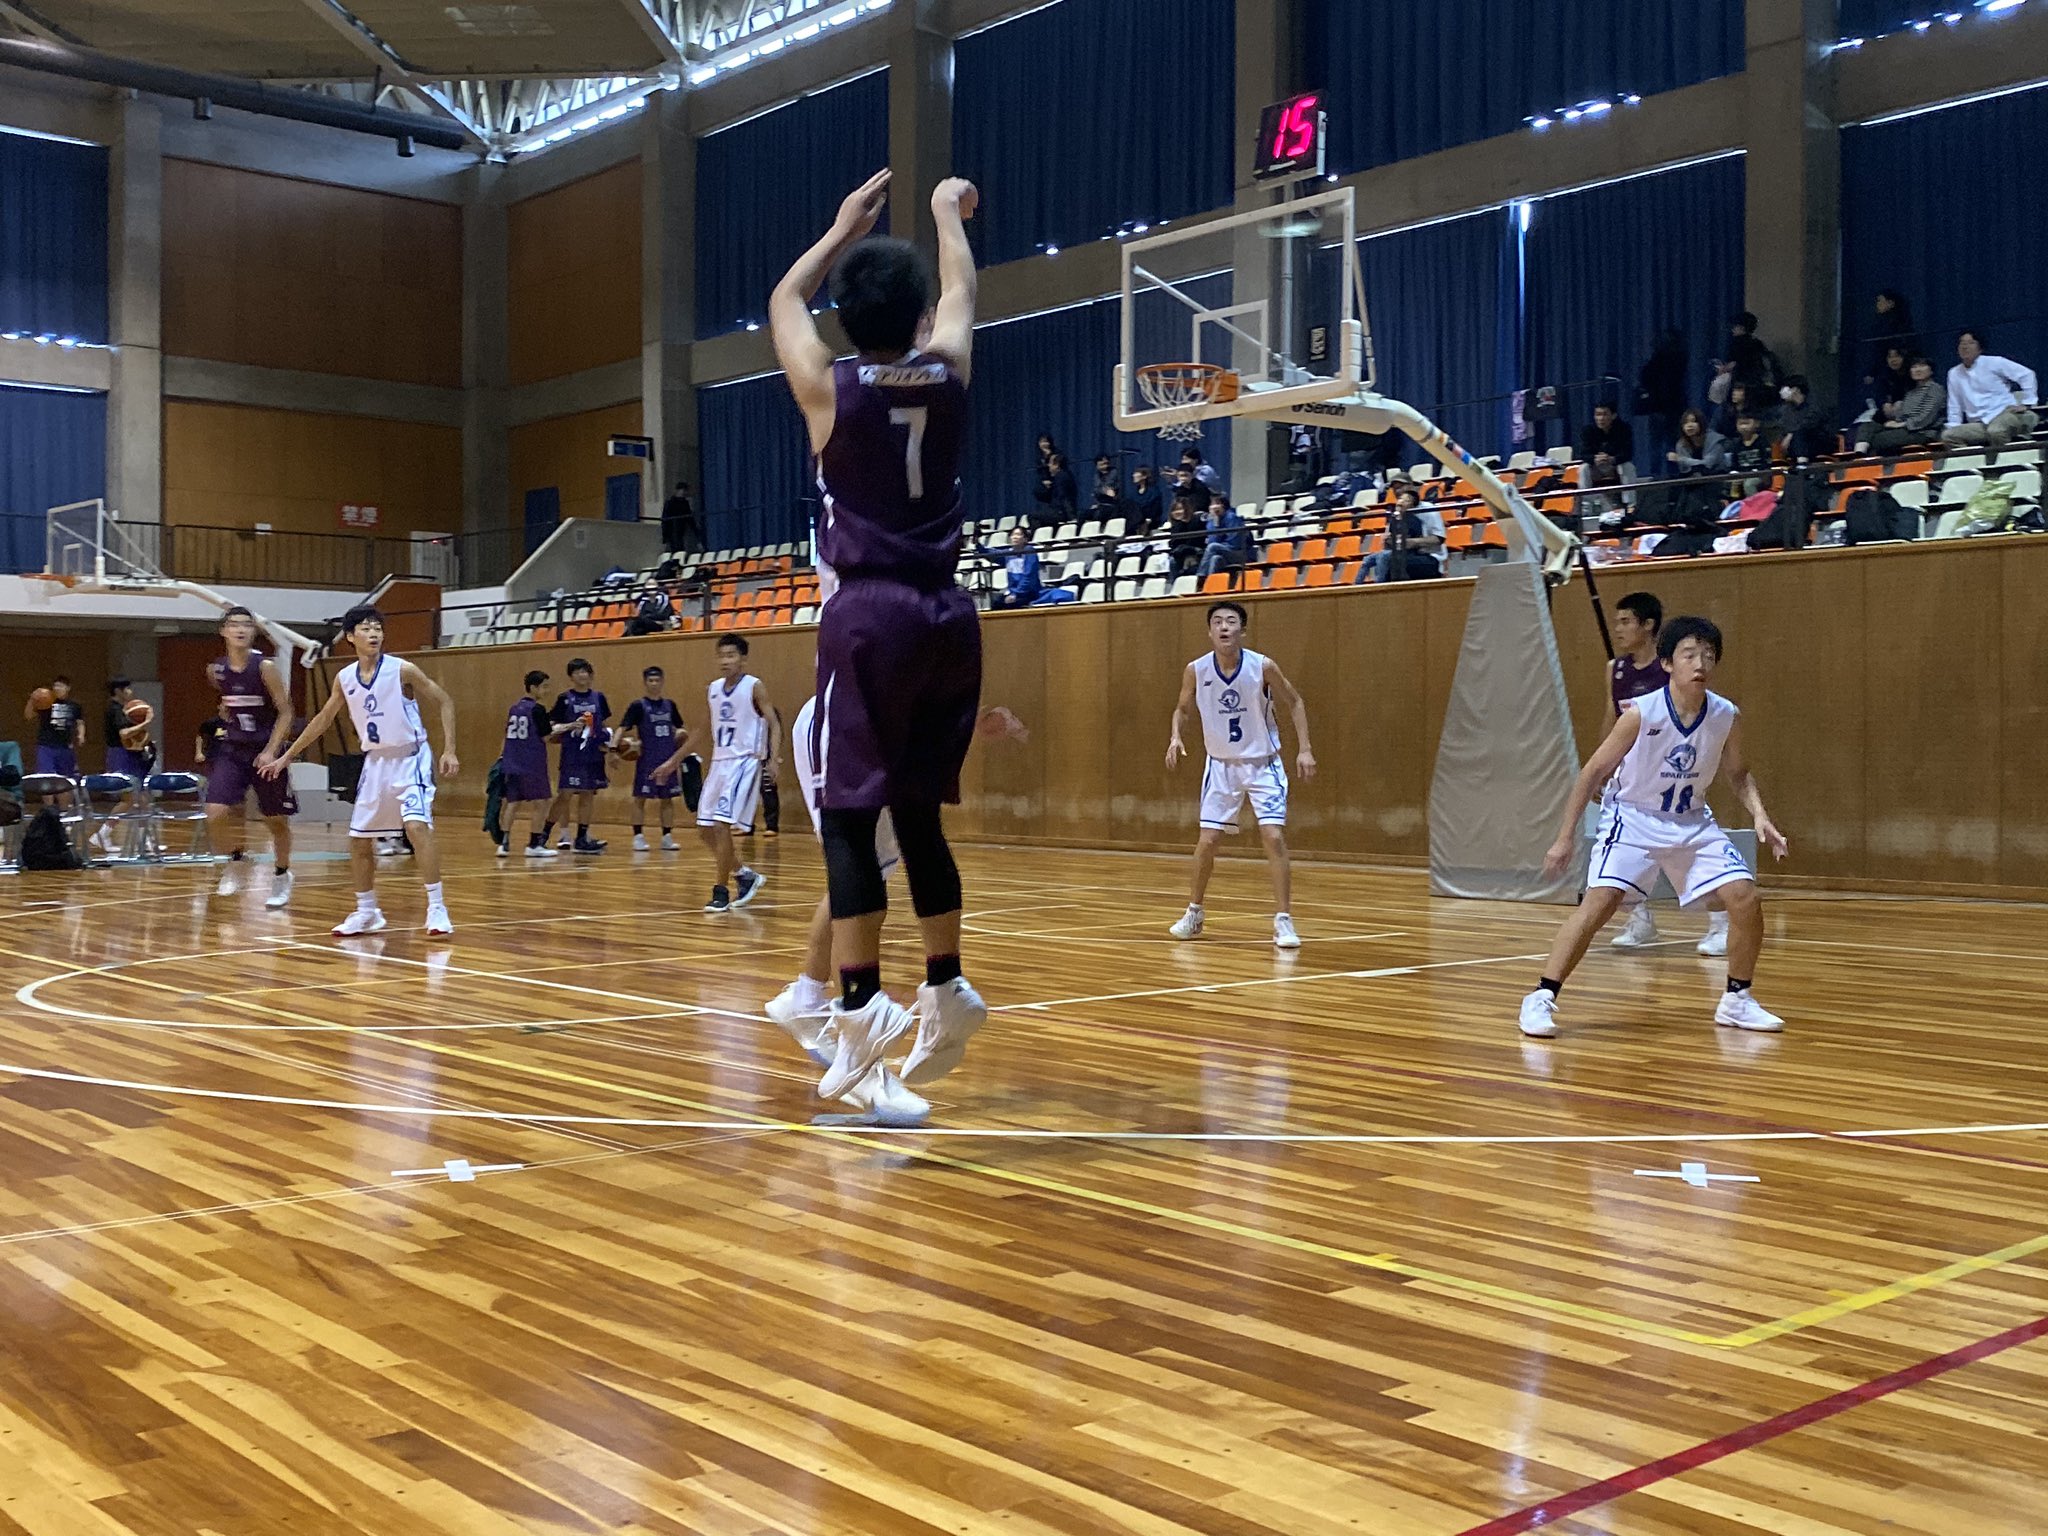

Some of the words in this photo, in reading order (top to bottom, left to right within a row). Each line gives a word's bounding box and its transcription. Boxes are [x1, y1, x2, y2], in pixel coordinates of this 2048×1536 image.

[1273, 96, 1318, 159] 15
[1303, 402, 1346, 417] Senoh
[888, 406, 928, 499] 7
[506, 715, 529, 740] 28
[717, 726, 736, 747] 17
[1228, 716, 1243, 743] 5
